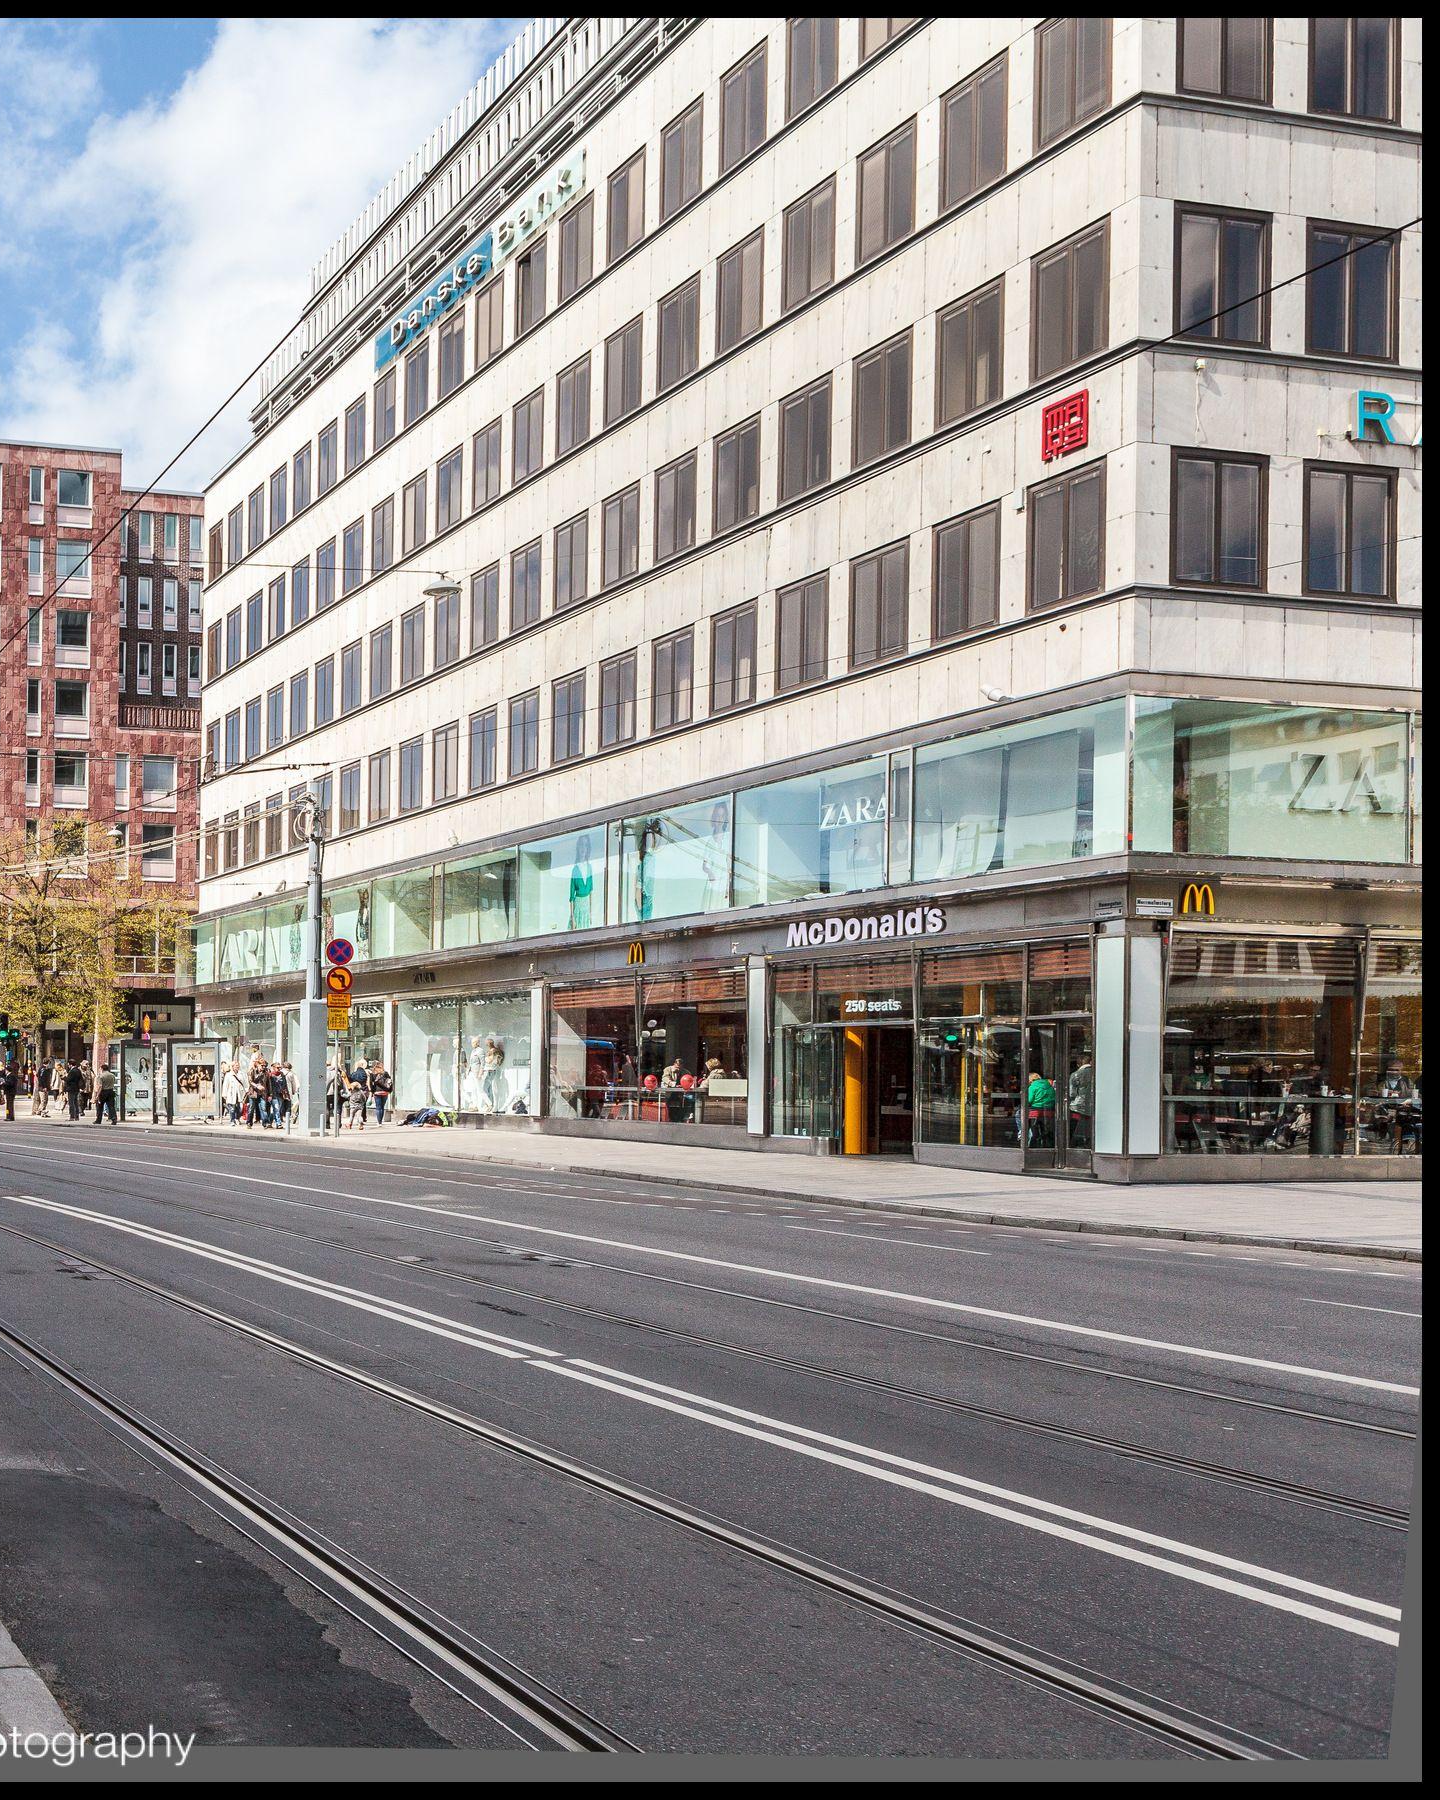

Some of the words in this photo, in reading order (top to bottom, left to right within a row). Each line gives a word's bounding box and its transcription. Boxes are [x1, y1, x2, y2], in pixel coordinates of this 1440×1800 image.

[390, 253, 487, 346] Danske
[498, 169, 573, 250] Bank
[819, 793, 887, 831] ZARA
[786, 906, 945, 948] McDonald's
[845, 1000, 867, 1012] 250
[867, 999, 902, 1012] seats
